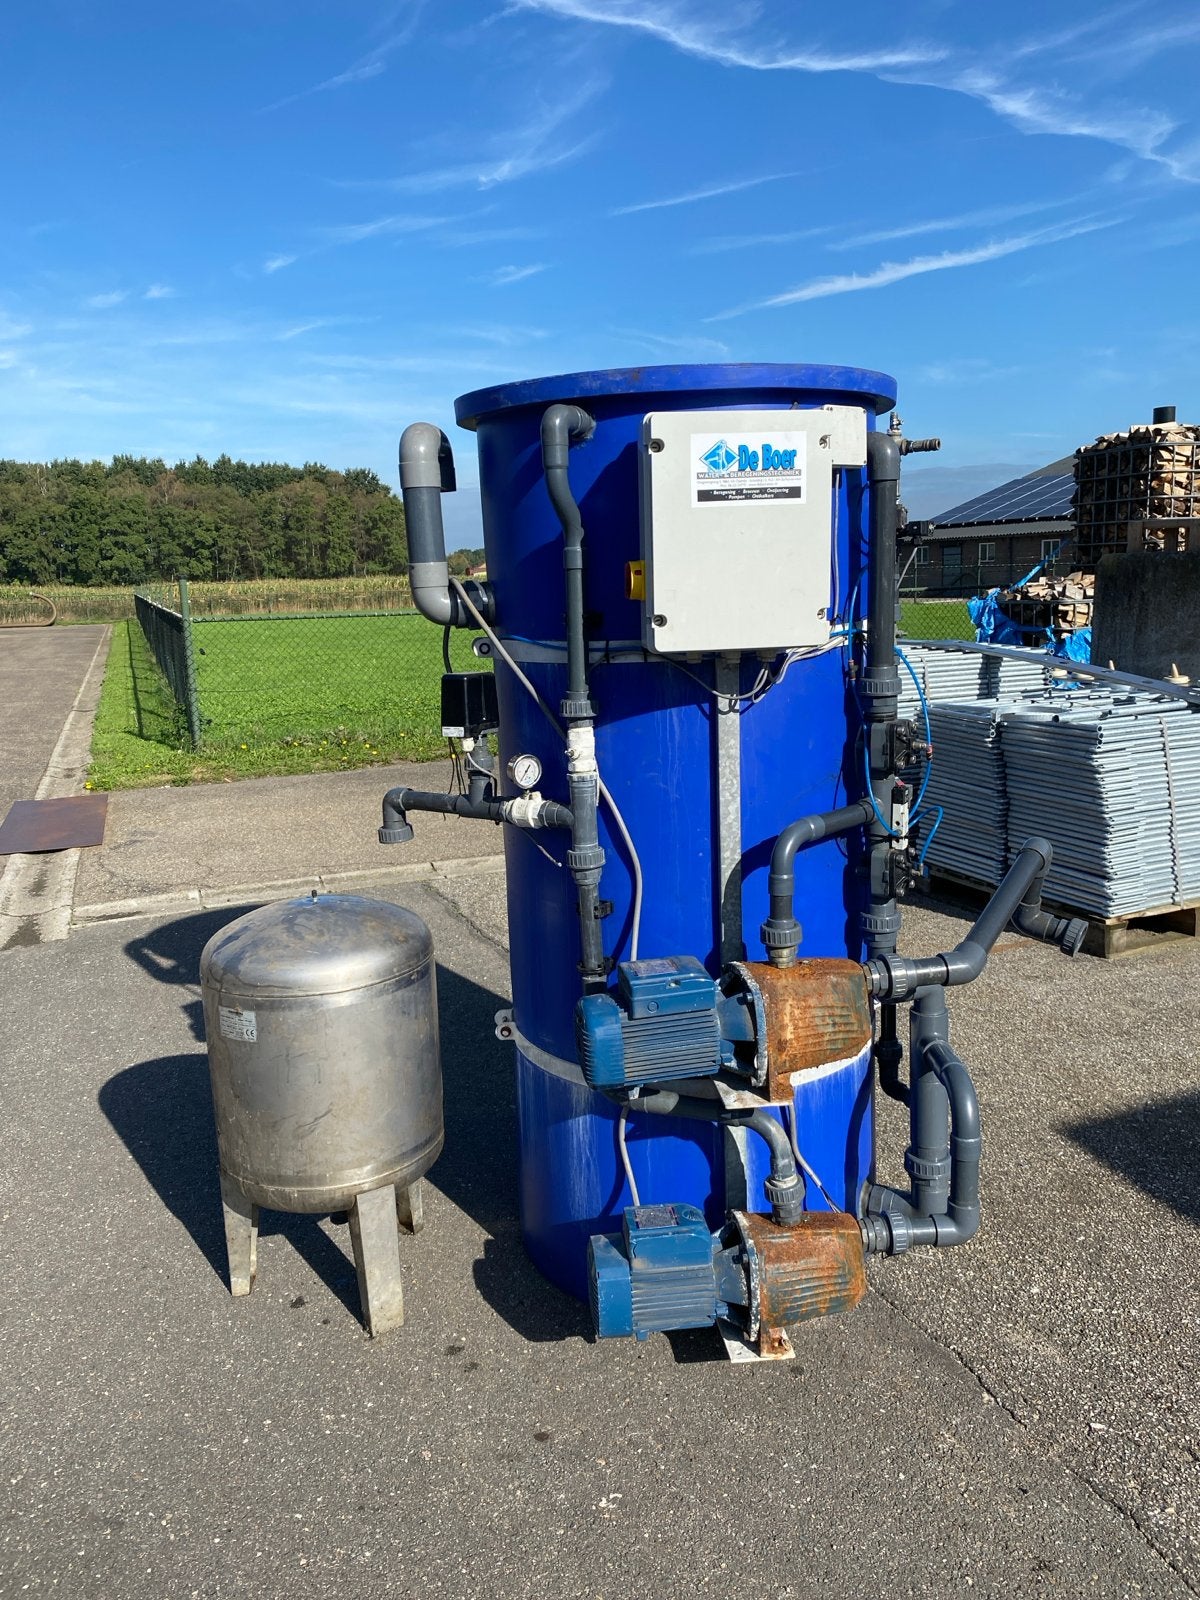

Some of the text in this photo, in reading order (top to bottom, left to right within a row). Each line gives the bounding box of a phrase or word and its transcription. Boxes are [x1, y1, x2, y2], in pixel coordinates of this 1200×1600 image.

[738, 444, 797, 471] De Boer
[730, 470, 800, 479] BEREGENINGSTECHNIEK
